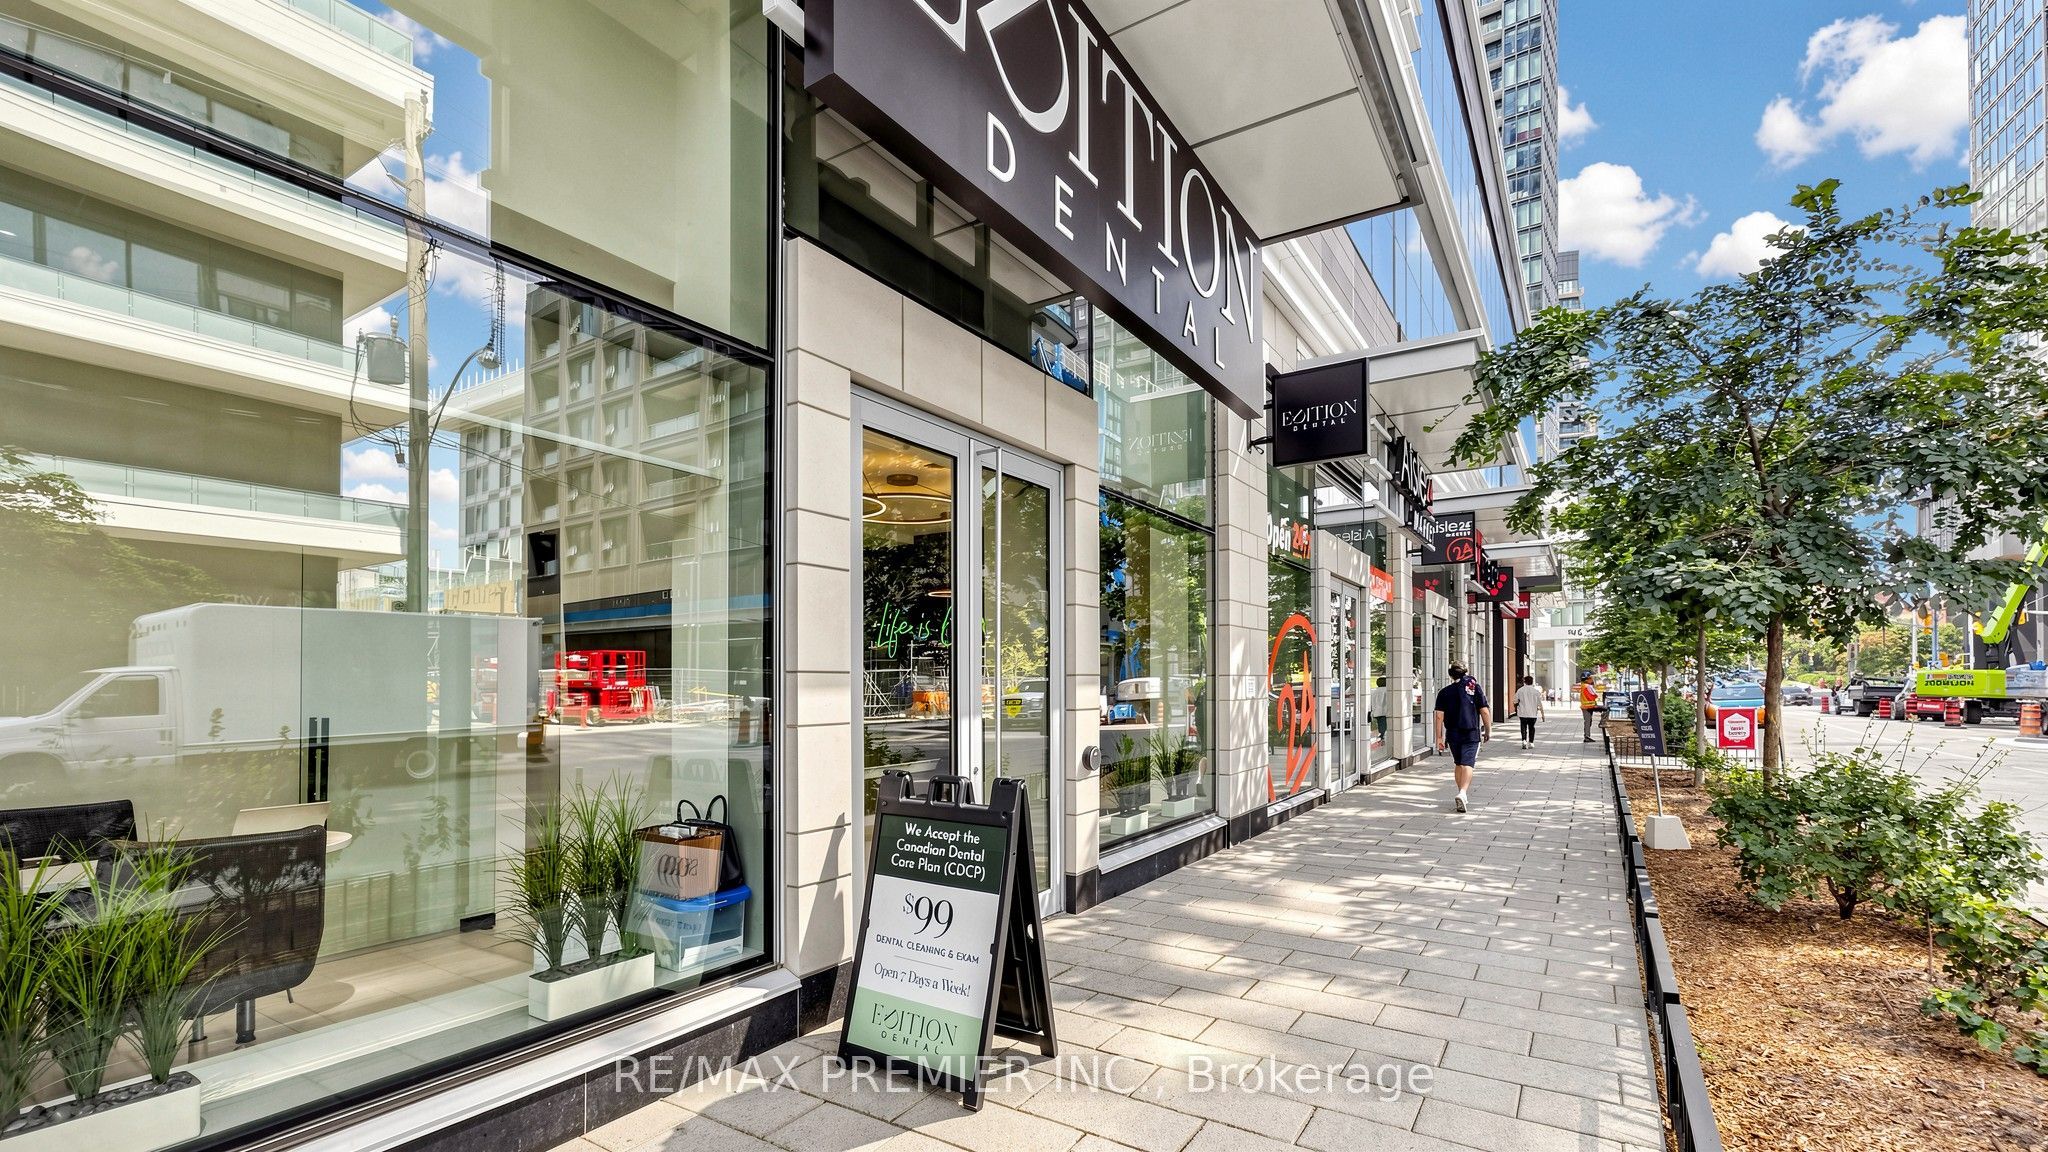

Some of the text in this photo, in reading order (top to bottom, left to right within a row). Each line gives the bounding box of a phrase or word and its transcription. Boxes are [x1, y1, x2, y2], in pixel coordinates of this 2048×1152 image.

[911, 0, 1258, 343] DITION
[986, 110, 1226, 370] DENTAL
[1282, 398, 1358, 427] EDITION
[1292, 417, 1346, 432] DENTAL
[1266, 513, 1291, 556] Open
[878, 602, 913, 658] Life
[918, 612, 931, 639] is
[905, 822, 980, 845] We Accept the
[896, 838, 985, 863] Canadian Dental
[891, 853, 986, 882] Care Plan (CDCP)
[902, 892, 954, 940] $99
[876, 934, 979, 964] DENTAL CLEANING & EXAM
[874, 962, 971, 997] Open 7 Days a Week!
[871, 1002, 958, 1047] EDITION
[880, 1030, 940, 1056] DENTAL
